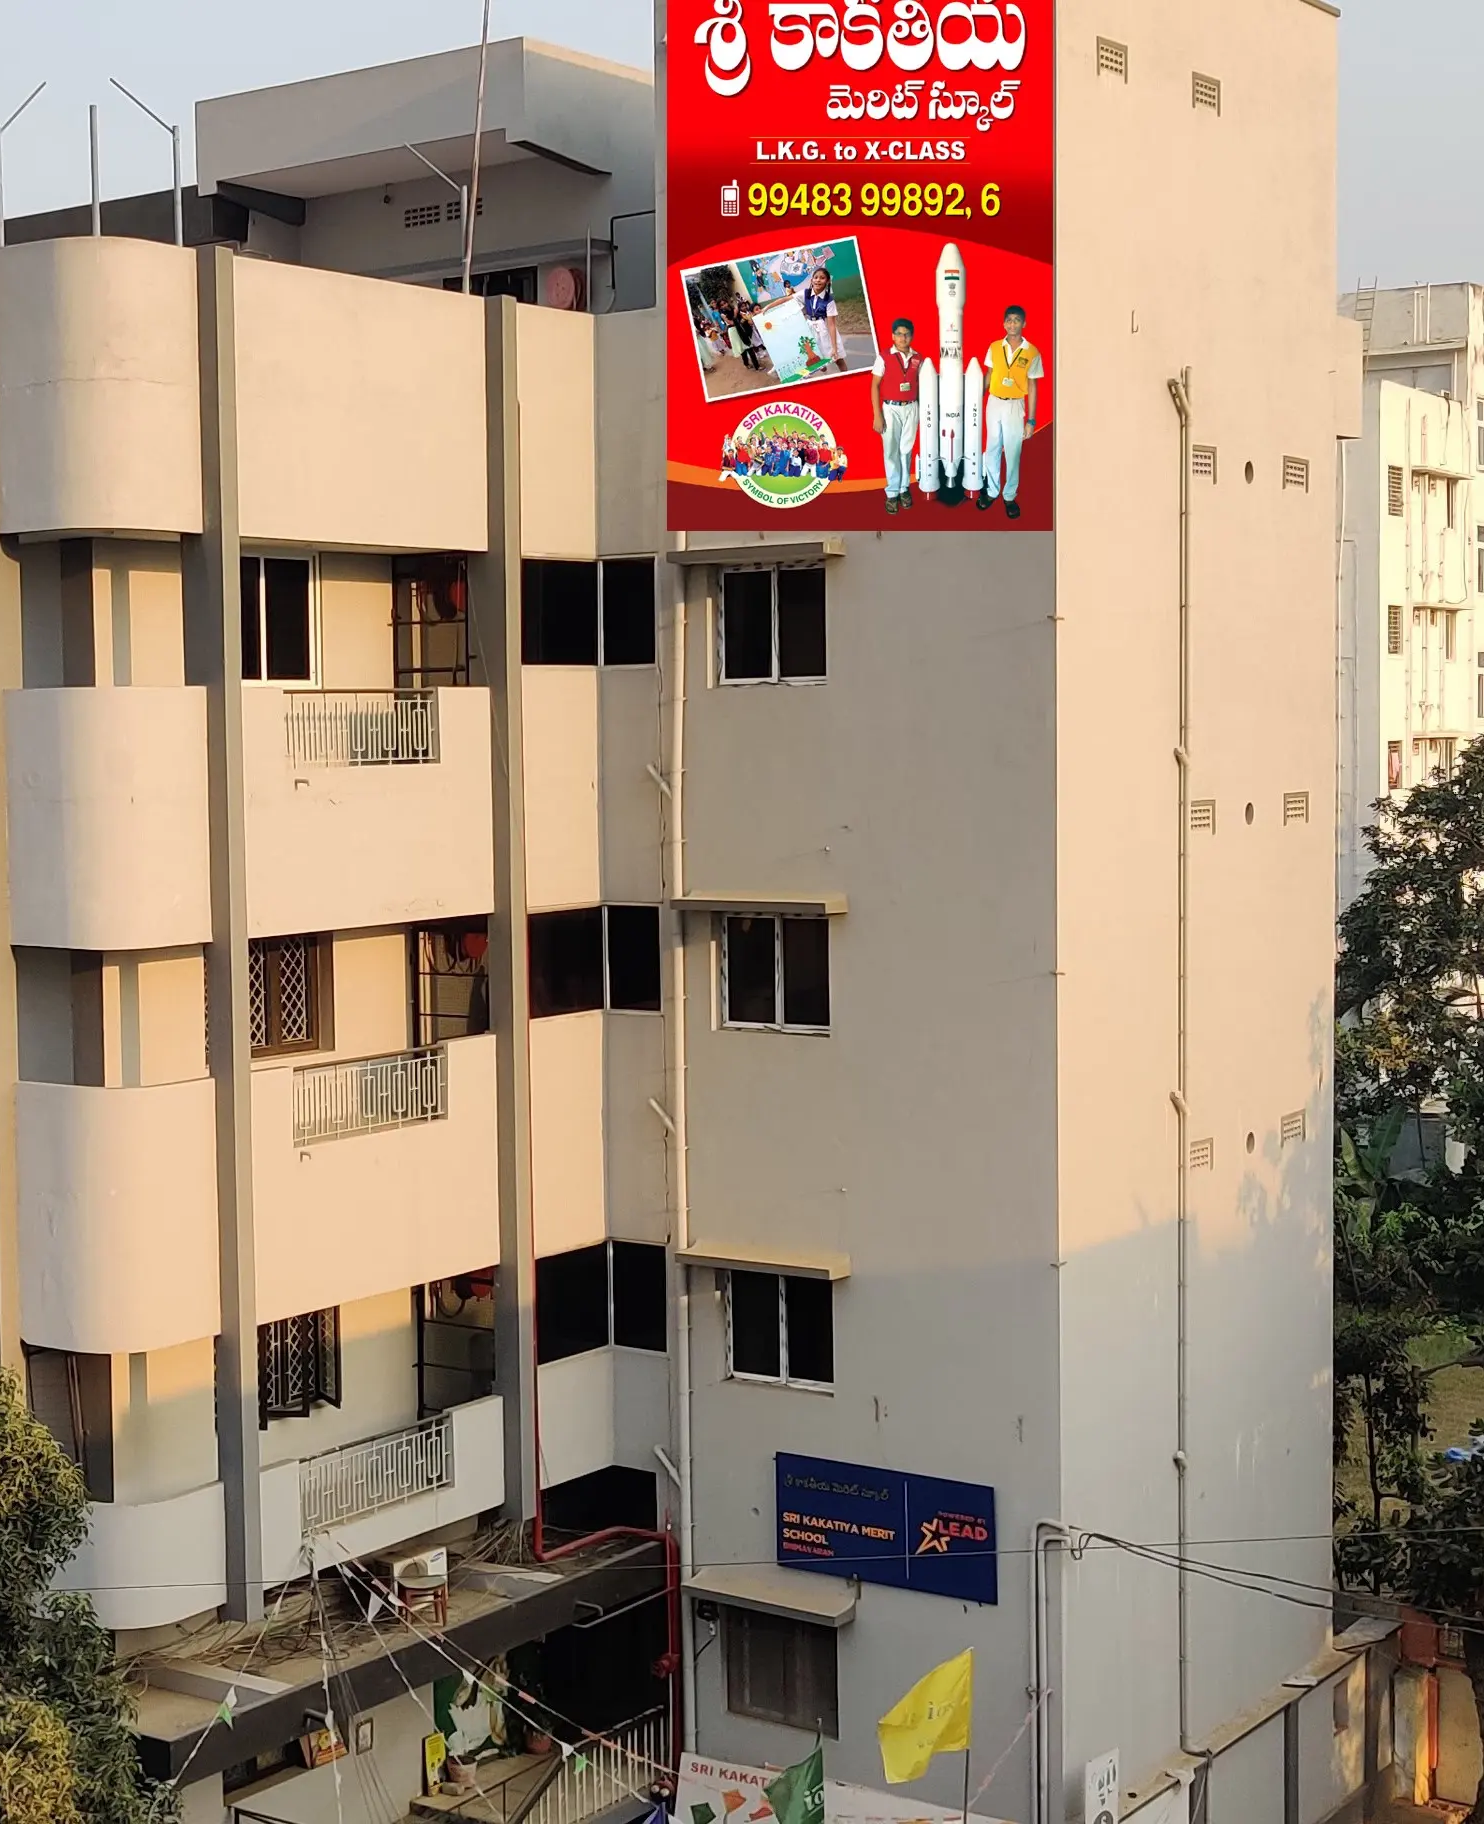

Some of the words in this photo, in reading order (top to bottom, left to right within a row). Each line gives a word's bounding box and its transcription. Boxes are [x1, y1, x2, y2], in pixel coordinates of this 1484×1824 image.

[827, 80, 925, 120] మెరిట్
[928, 80, 1021, 131] స్కూల్
[756, 141, 826, 160] L.K.G.
[834, 141, 857, 160] to
[864, 141, 966, 161] X-CLASS
[748, 183, 852, 217] 99483
[860, 183, 972, 220] 99892,
[981, 183, 1001, 217] 6
[743, 410, 763, 431] SRI
[764, 403, 823, 431] KAKATIYA
[742, 478, 774, 504] SYMBOL
[776, 497, 790, 505] OF
[790, 480, 824, 504] VICTORY
[782, 1511, 801, 1524] SRI
[802, 1515, 860, 1535] KAKATIYA
[861, 1525, 896, 1541] MERIT
[782, 1528, 829, 1545] SCHOOL
[938, 1519, 989, 1541] LEAD
[690, 1761, 714, 1777] SRI
[718, 1767, 772, 1788] KAKAT
